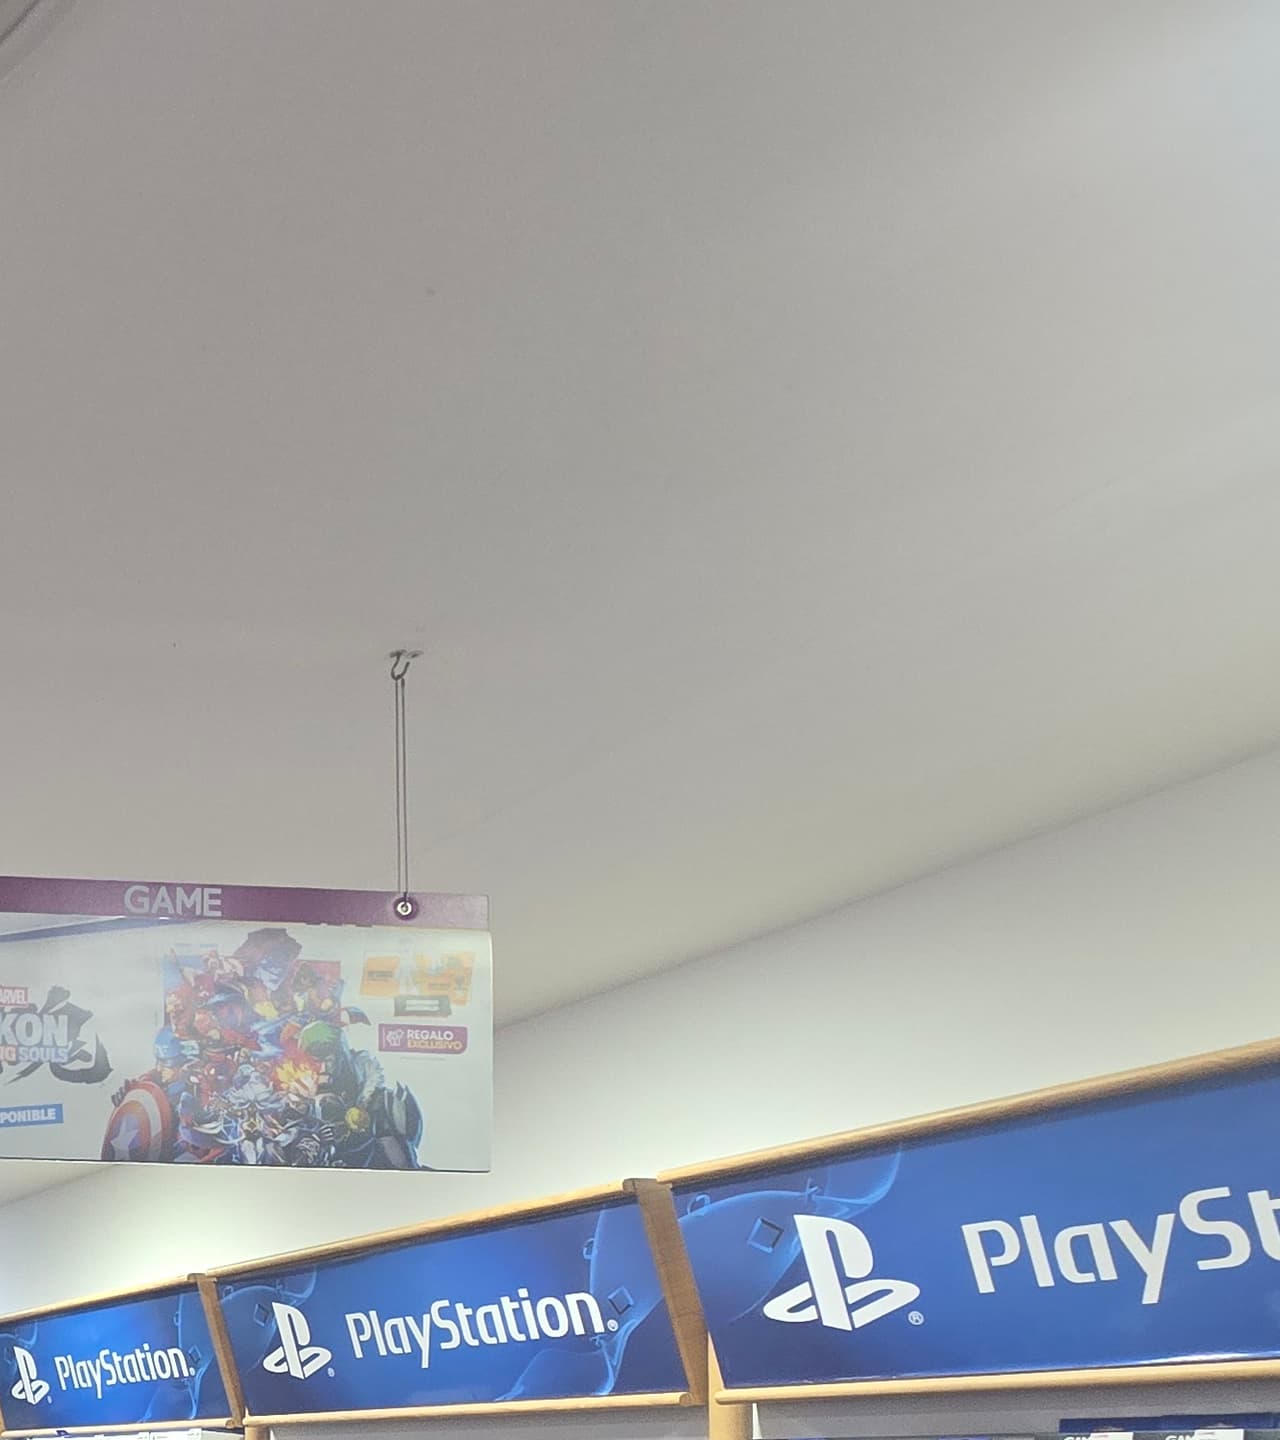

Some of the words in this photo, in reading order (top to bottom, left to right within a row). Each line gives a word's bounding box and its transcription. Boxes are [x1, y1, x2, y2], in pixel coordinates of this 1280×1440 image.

[124, 885, 222, 917] GAME
[406, 1028, 454, 1042] REGALO
[406, 1037, 462, 1050] EXCLUSIVO
[18, 1047, 69, 1063] SOULS
[961, 1185, 1280, 1305] PlaySt
[345, 1286, 605, 1370] PlayStation
[55, 1343, 191, 1399] PlayStation
